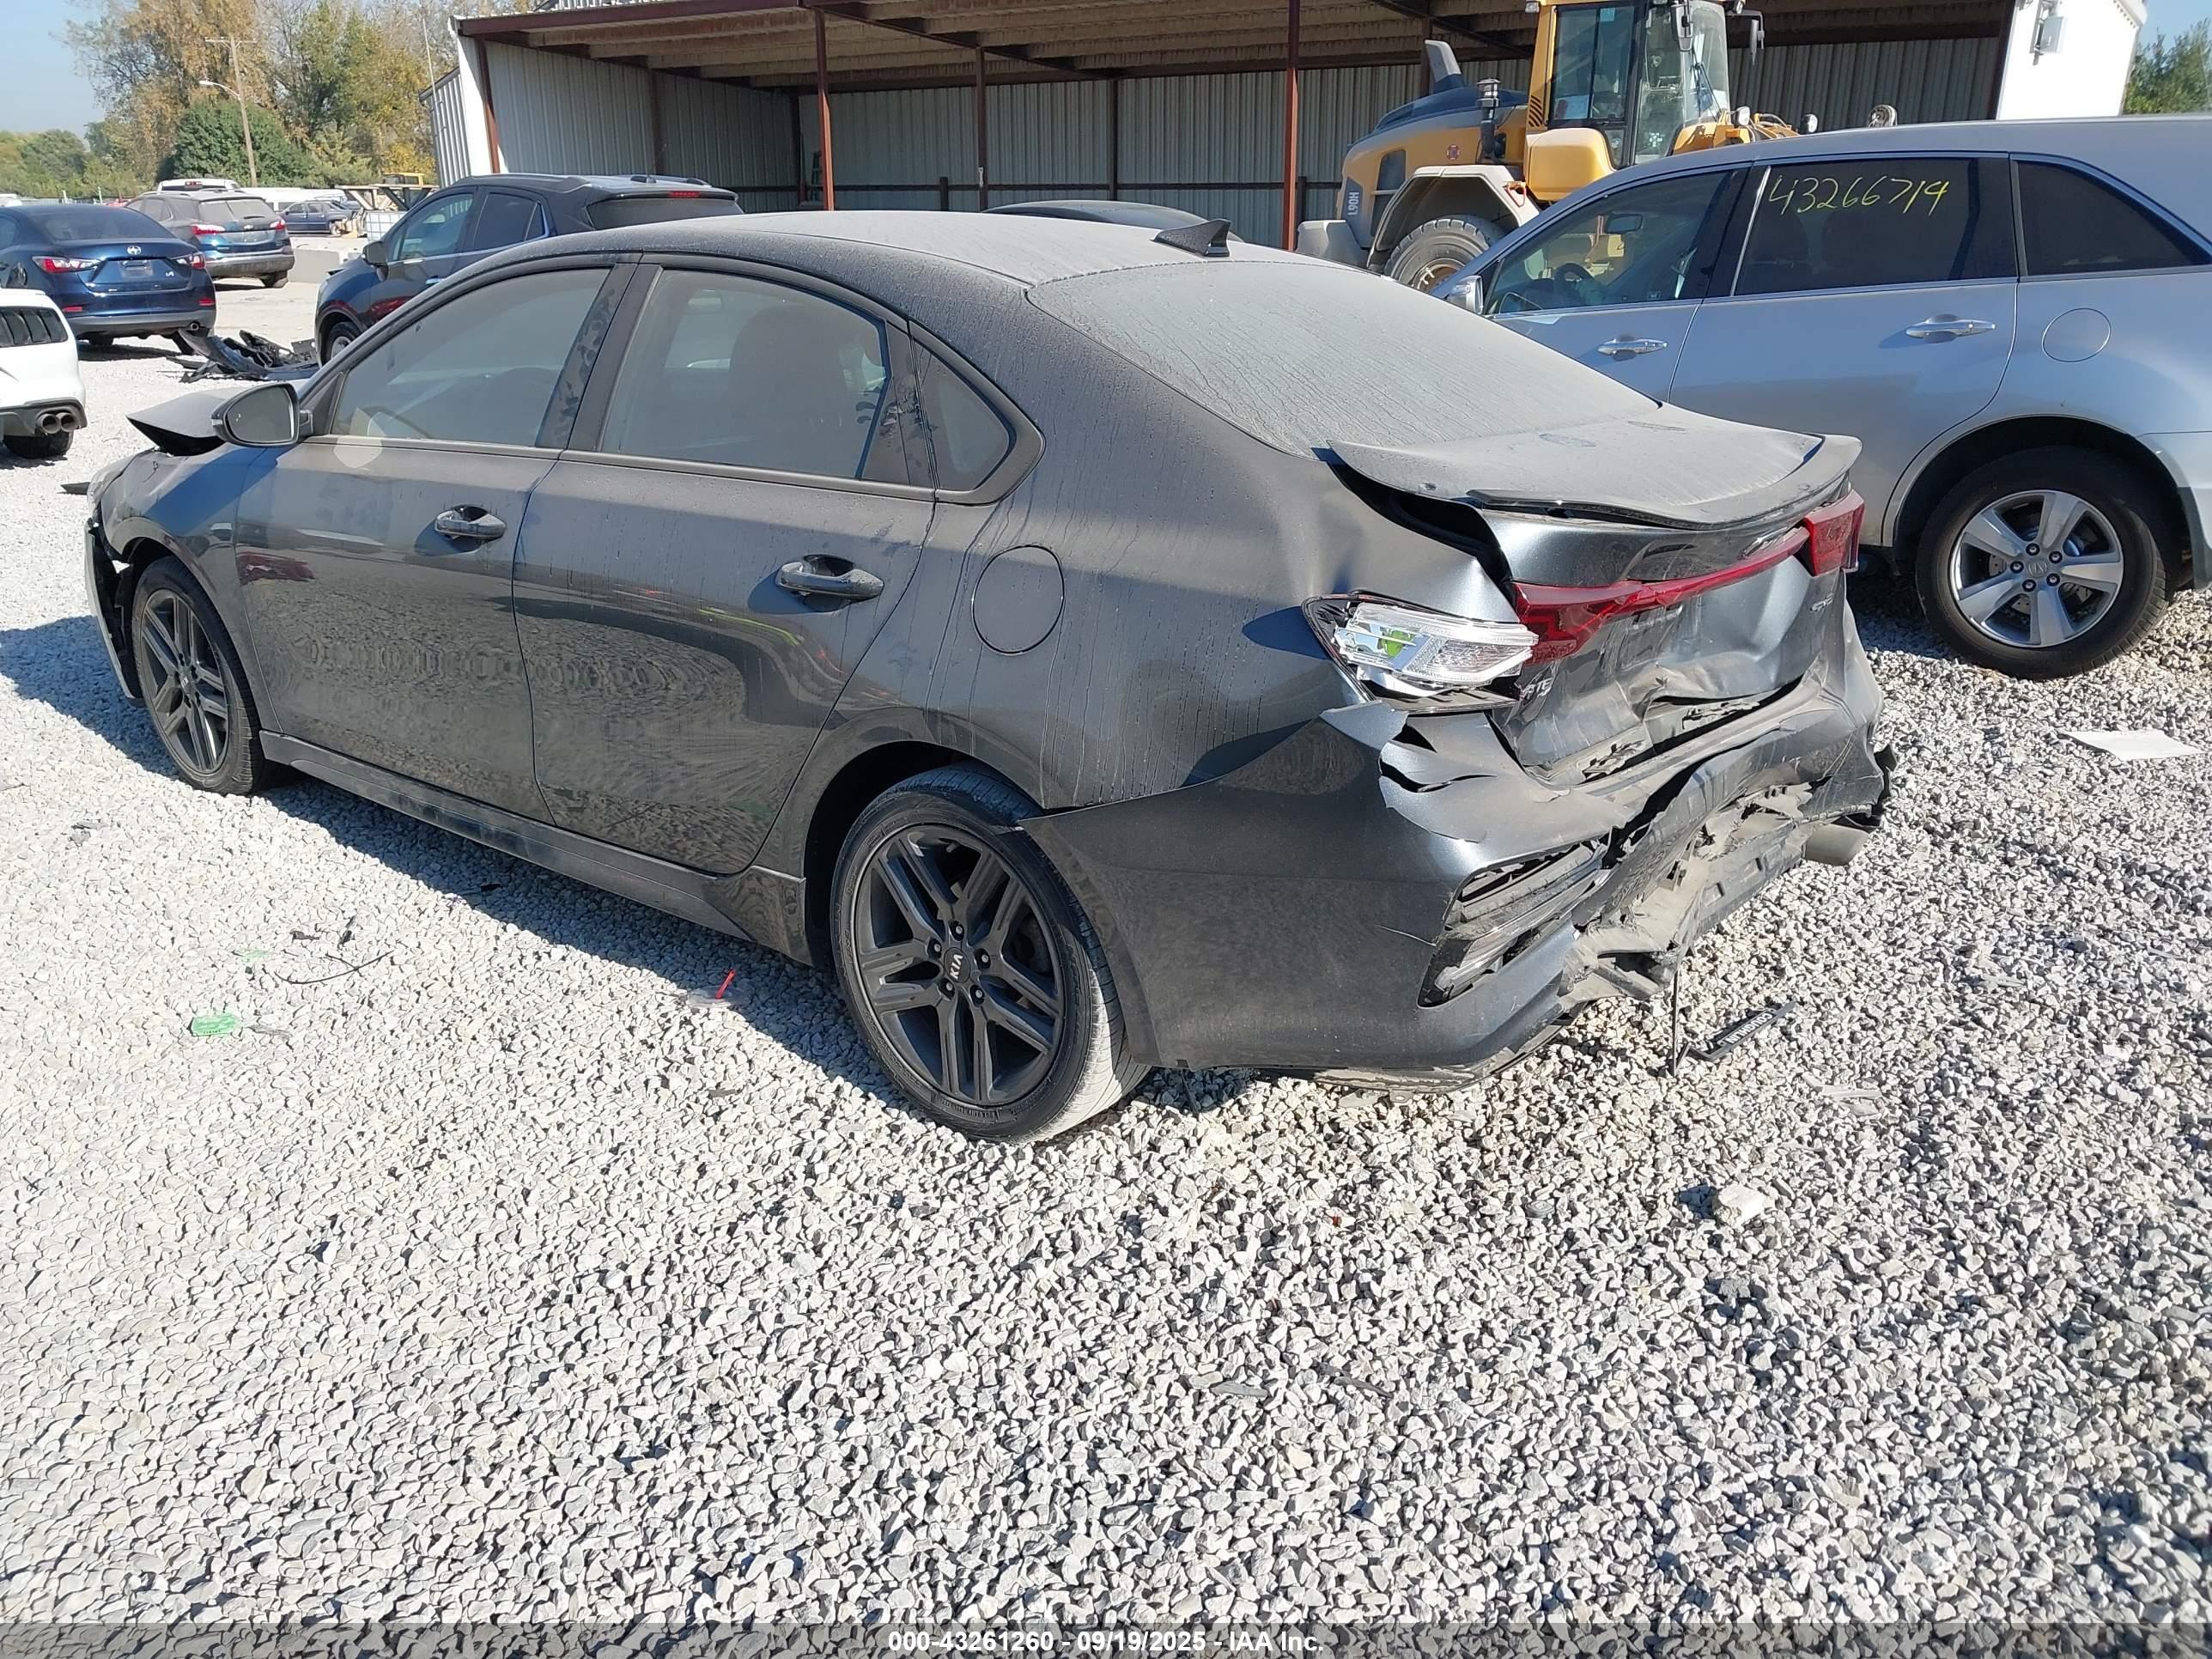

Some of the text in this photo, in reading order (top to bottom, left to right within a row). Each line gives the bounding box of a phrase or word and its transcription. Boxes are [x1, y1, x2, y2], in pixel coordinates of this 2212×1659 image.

[1347, 191, 1360, 216] L90H
[949, 953, 963, 980] KIA
[1724, 1012, 1773, 1044] COUGHLIN
